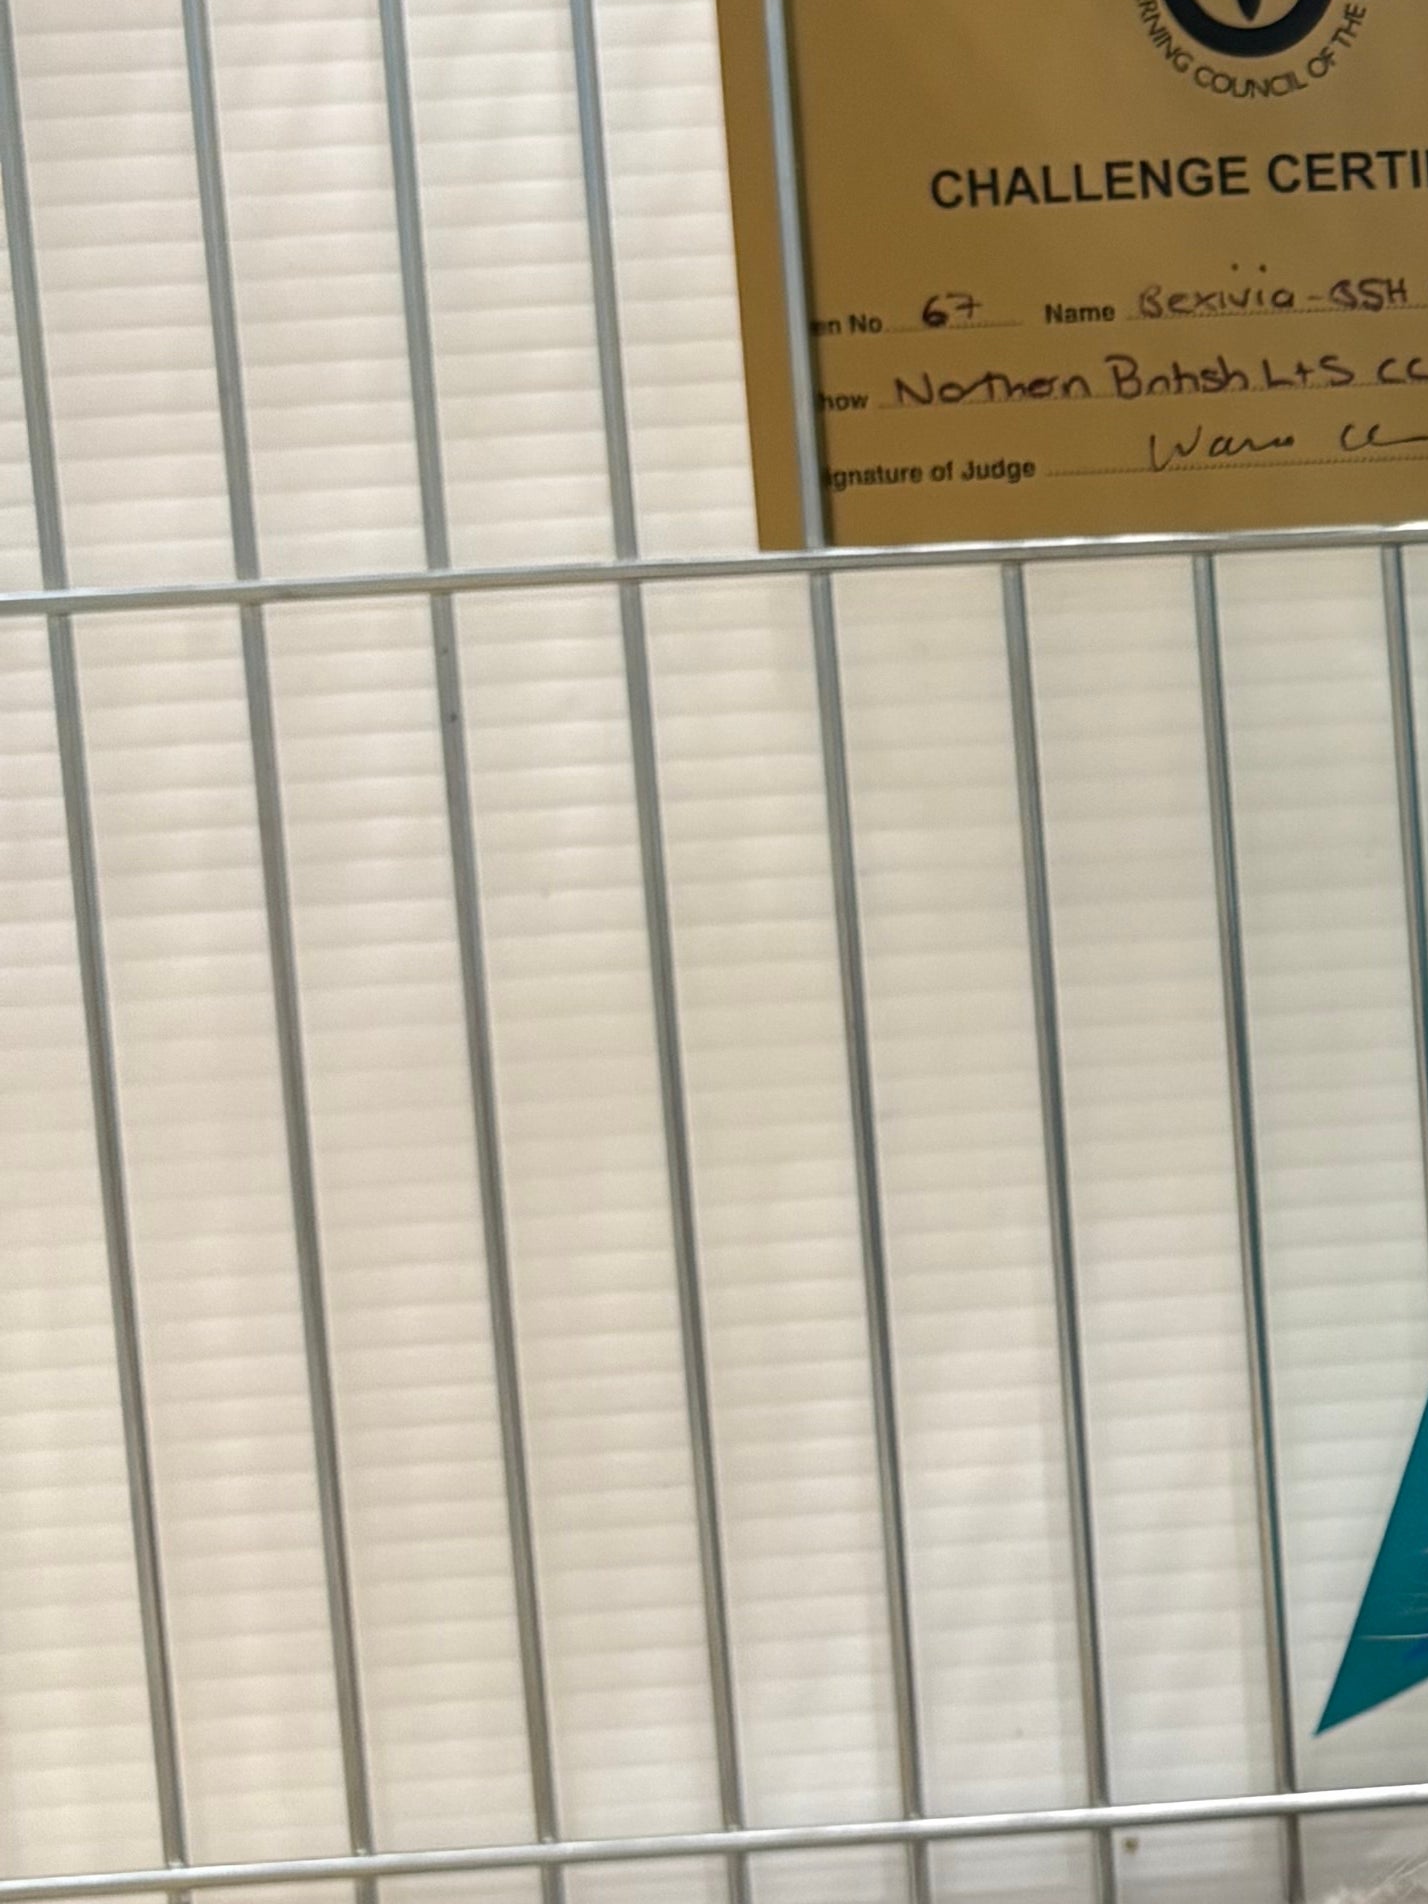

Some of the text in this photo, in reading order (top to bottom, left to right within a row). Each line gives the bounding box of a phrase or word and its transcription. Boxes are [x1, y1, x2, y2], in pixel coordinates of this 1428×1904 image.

[1194, 66, 1309, 99] COUNCIL
[1307, 47, 1336, 79] OF
[1332, 2, 1367, 49] THE
[930, 155, 1250, 211] CHALLENGE
[809, 318, 842, 337] en
[921, 292, 982, 328] 67
[1044, 303, 1116, 324] Name
[816, 392, 869, 411] how
[820, 457, 1036, 493] ignature of Judge
